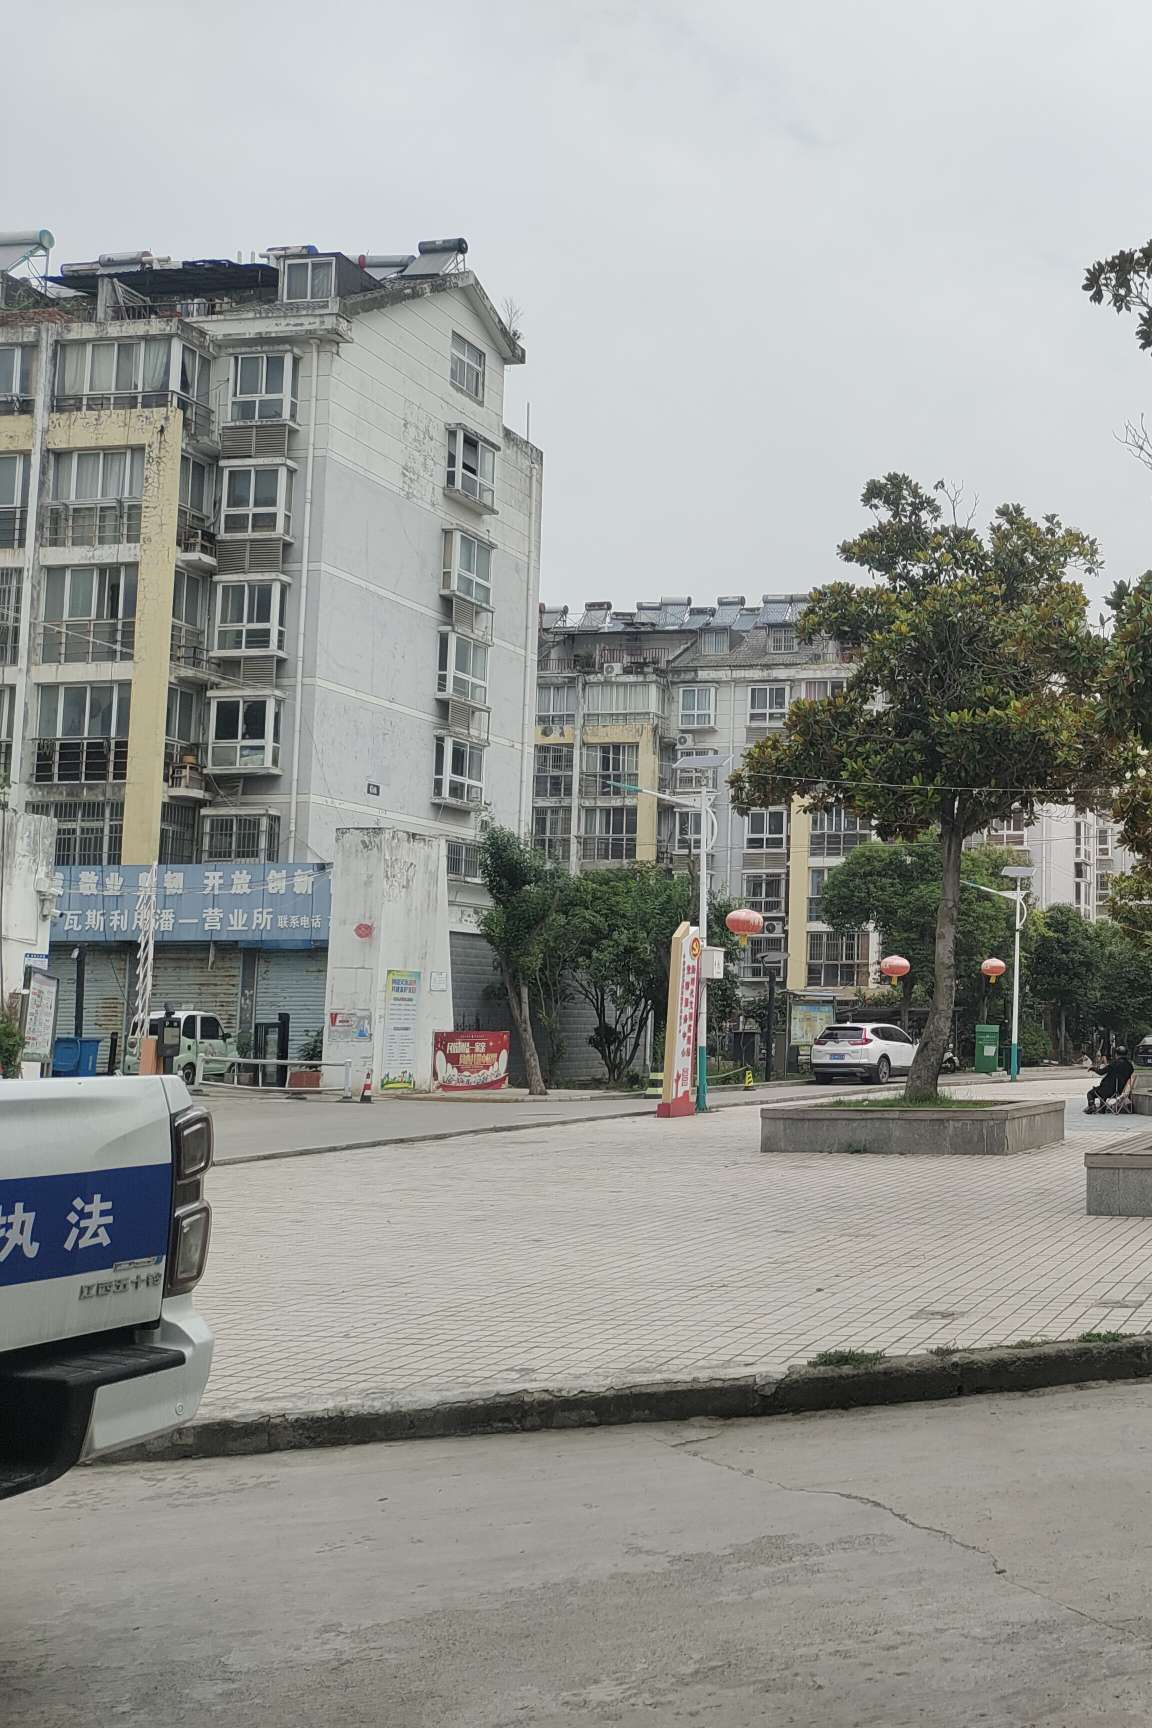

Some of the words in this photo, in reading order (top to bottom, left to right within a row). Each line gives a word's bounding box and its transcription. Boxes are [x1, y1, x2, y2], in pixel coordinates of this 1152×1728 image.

[203, 870, 252, 895] 开放
[266, 869, 315, 895] 创新
[277, 914, 322, 929] 联系电话
[0, 1193, 114, 1263] 执法
